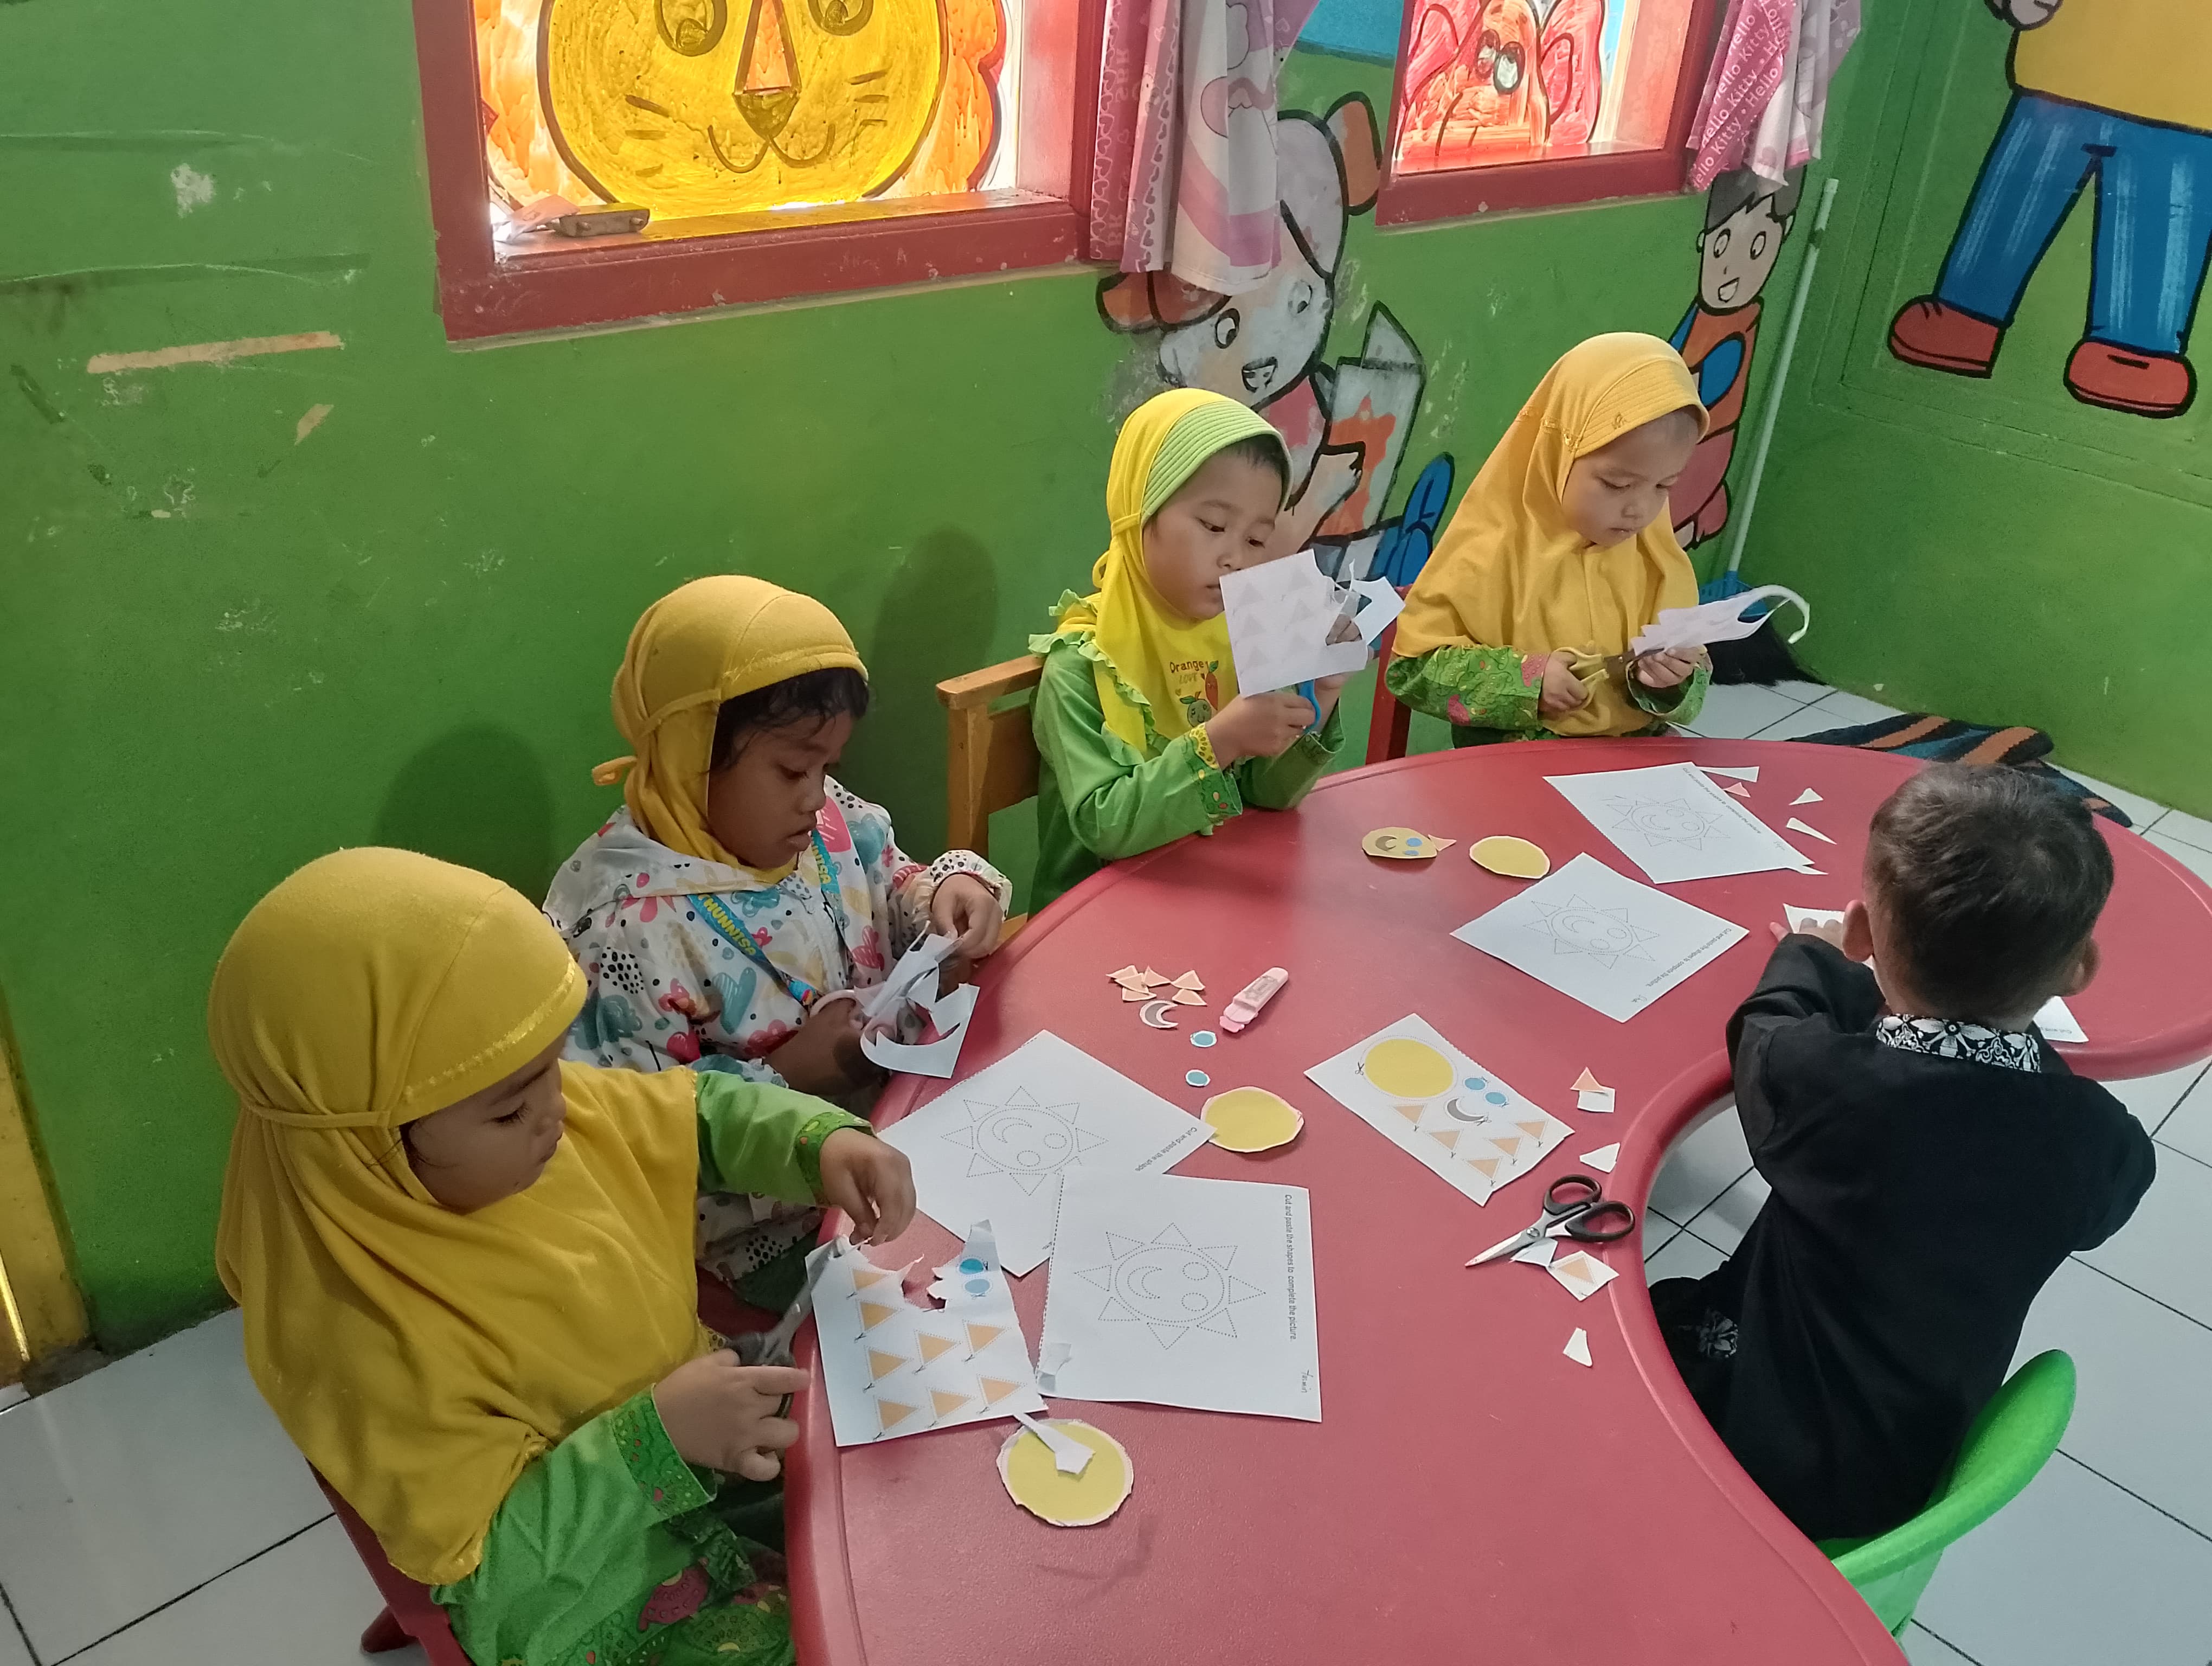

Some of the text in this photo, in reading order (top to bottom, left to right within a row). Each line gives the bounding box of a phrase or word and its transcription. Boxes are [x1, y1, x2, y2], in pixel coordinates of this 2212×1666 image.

[1739, 24, 1770, 62] Kitty
[1727, 69, 1758, 107] Kitty
[1711, 117, 1742, 155] Kitty
[1745, 67, 1779, 107] Hello
[1169, 661, 1204, 674] Orange
[1186, 1127, 1198, 1136] Cut
[1175, 1134, 1187, 1144] and
[1160, 1141, 1177, 1152] paste
[1152, 1152, 1164, 1161] the
[1284, 1194, 1293, 1204] Cut
[1285, 1205, 1293, 1216] and
[1283, 1216, 1293, 1233] paste
[1286, 1234, 1294, 1244] the
[1284, 1244, 1295, 1266] shapes
[1287, 1276, 1297, 1304] complete
[1289, 1305, 1297, 1316] the
